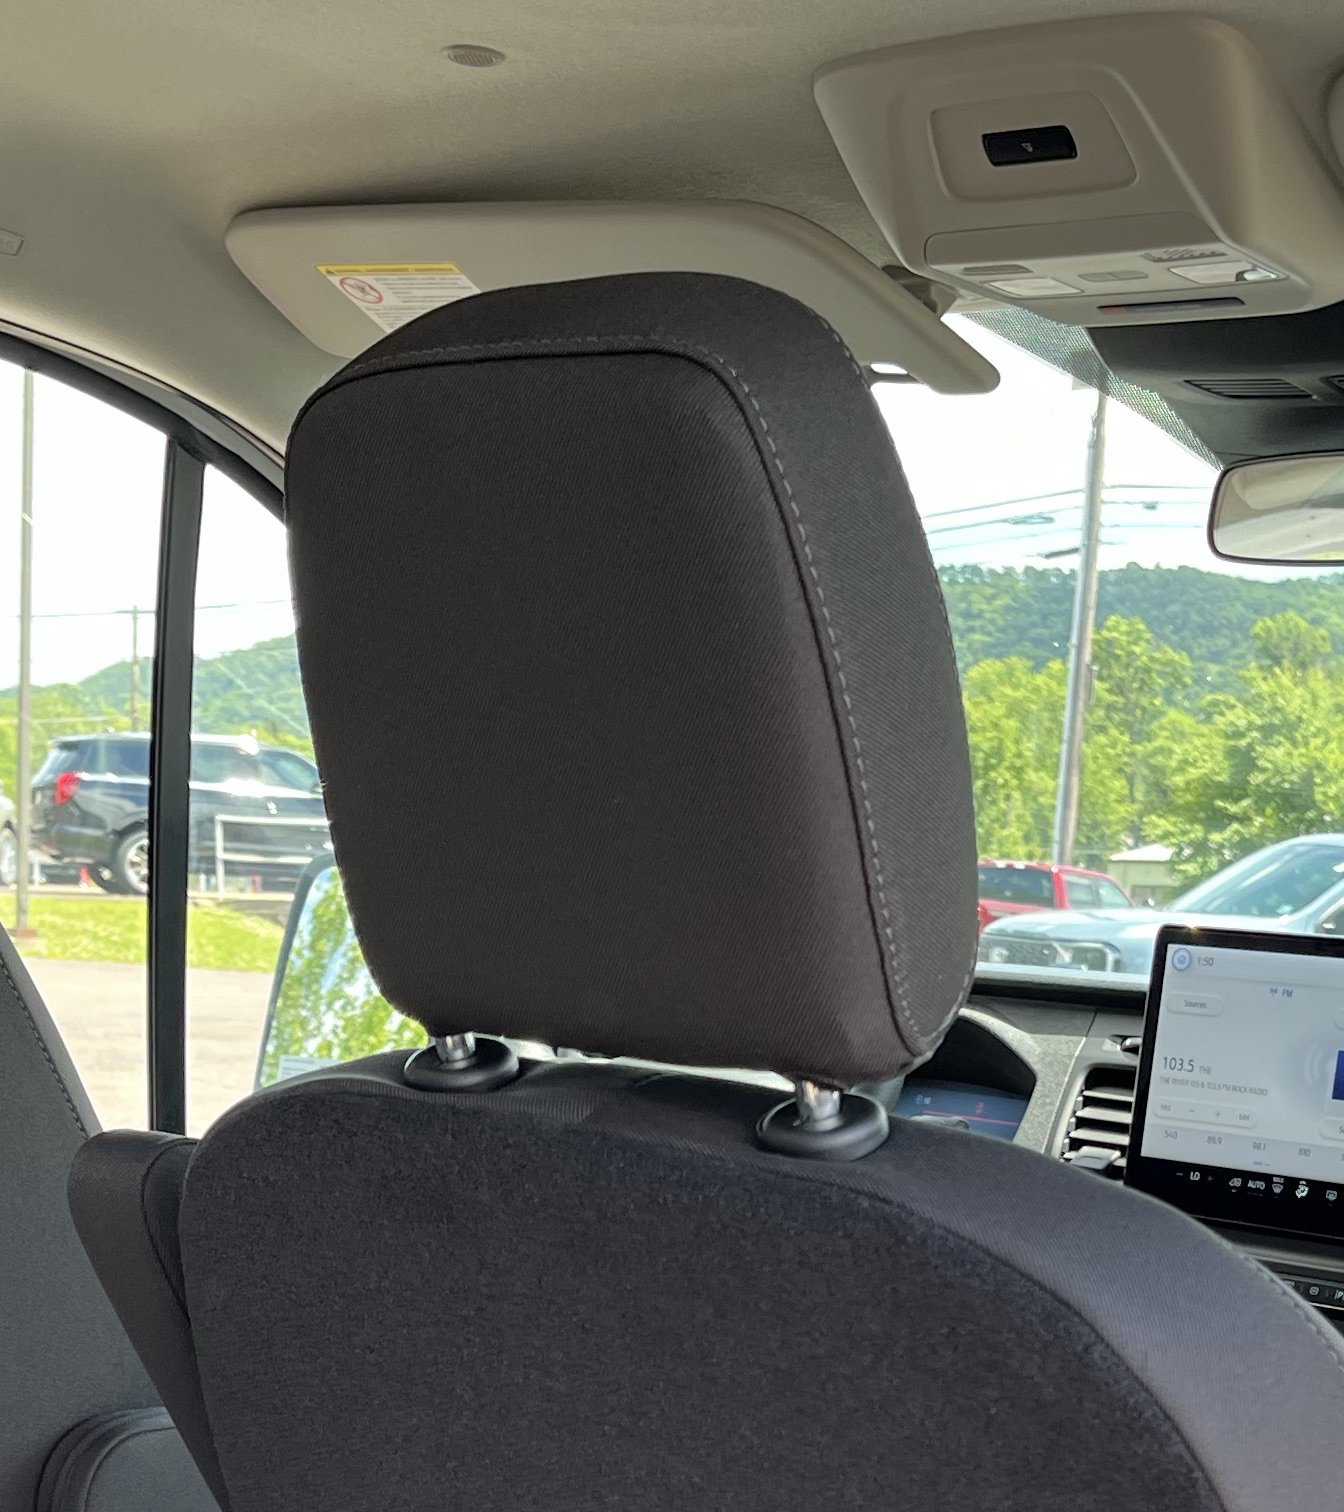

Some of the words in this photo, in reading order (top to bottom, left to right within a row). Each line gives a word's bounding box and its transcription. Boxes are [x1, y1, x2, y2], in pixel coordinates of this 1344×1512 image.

[1282, 988, 1293, 998] FM
[1184, 999, 1207, 1009] Sources
[1162, 1056, 1194, 1073] 103.5
[1247, 1179, 1265, 1190] AUTO
